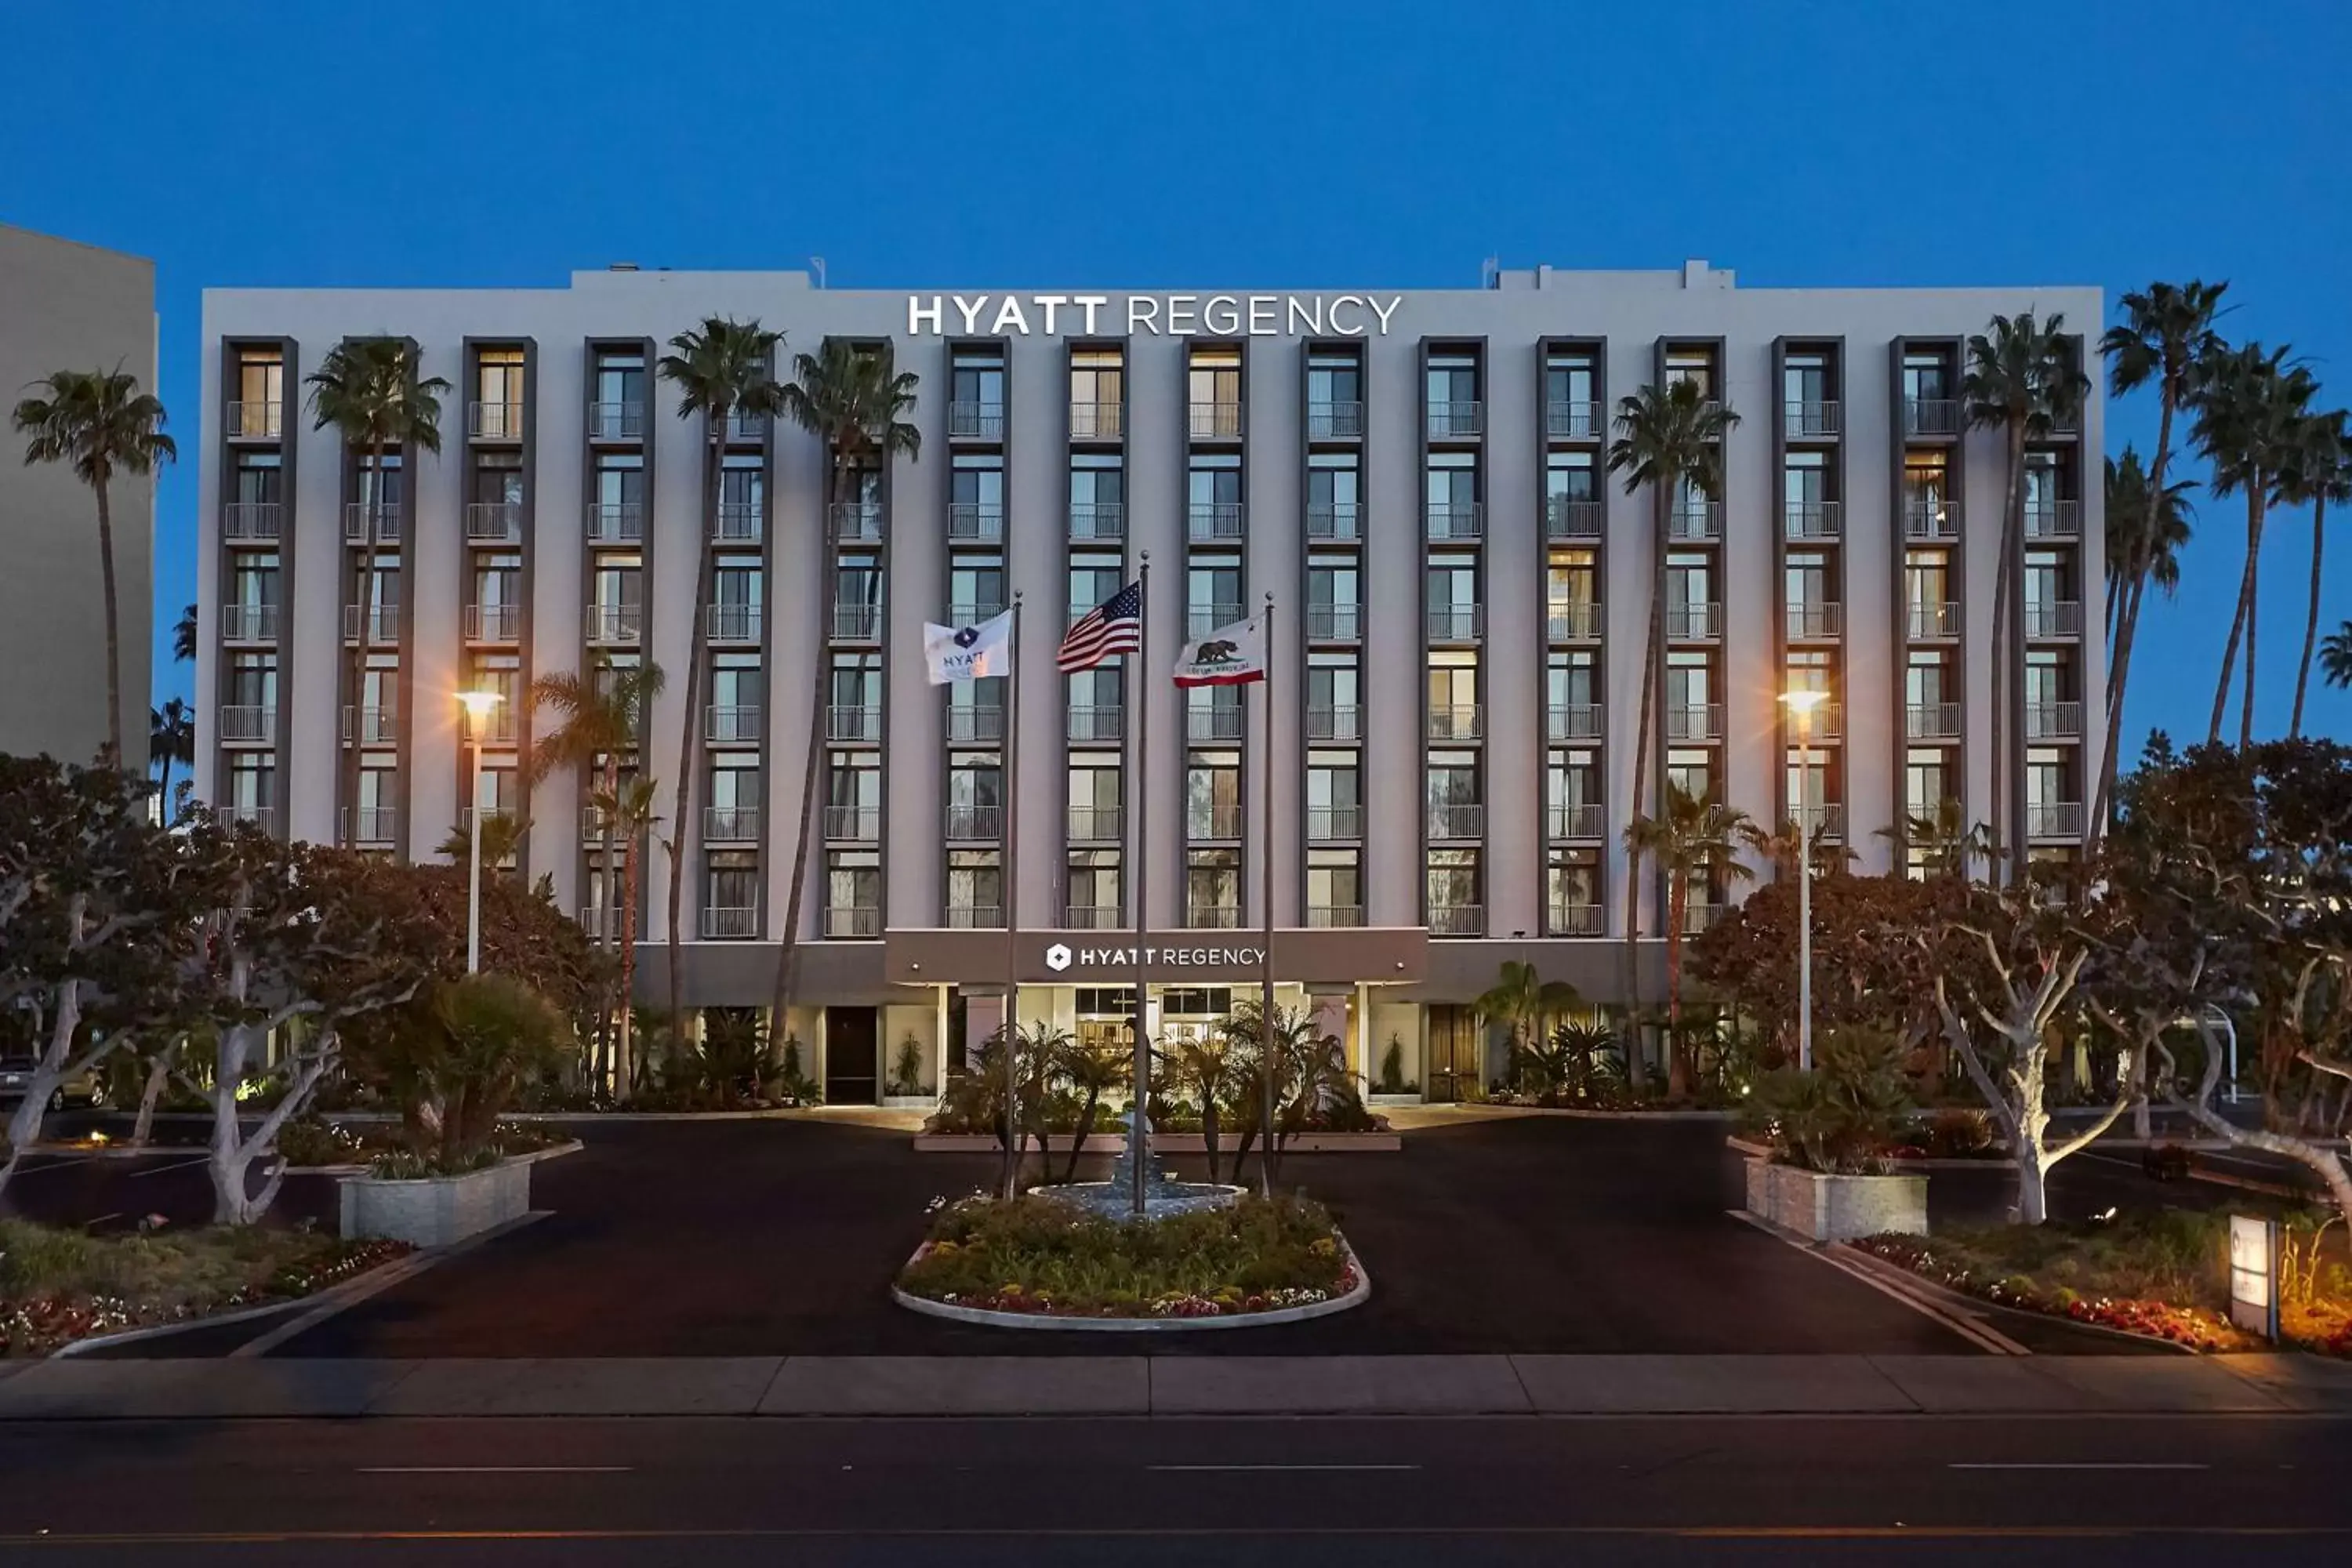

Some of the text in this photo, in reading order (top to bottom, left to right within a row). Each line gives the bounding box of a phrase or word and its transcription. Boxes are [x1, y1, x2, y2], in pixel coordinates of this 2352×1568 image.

[908, 295, 1402, 336] HYATT REGENCY
[1080, 948, 1266, 966] HYATT REGENCY
